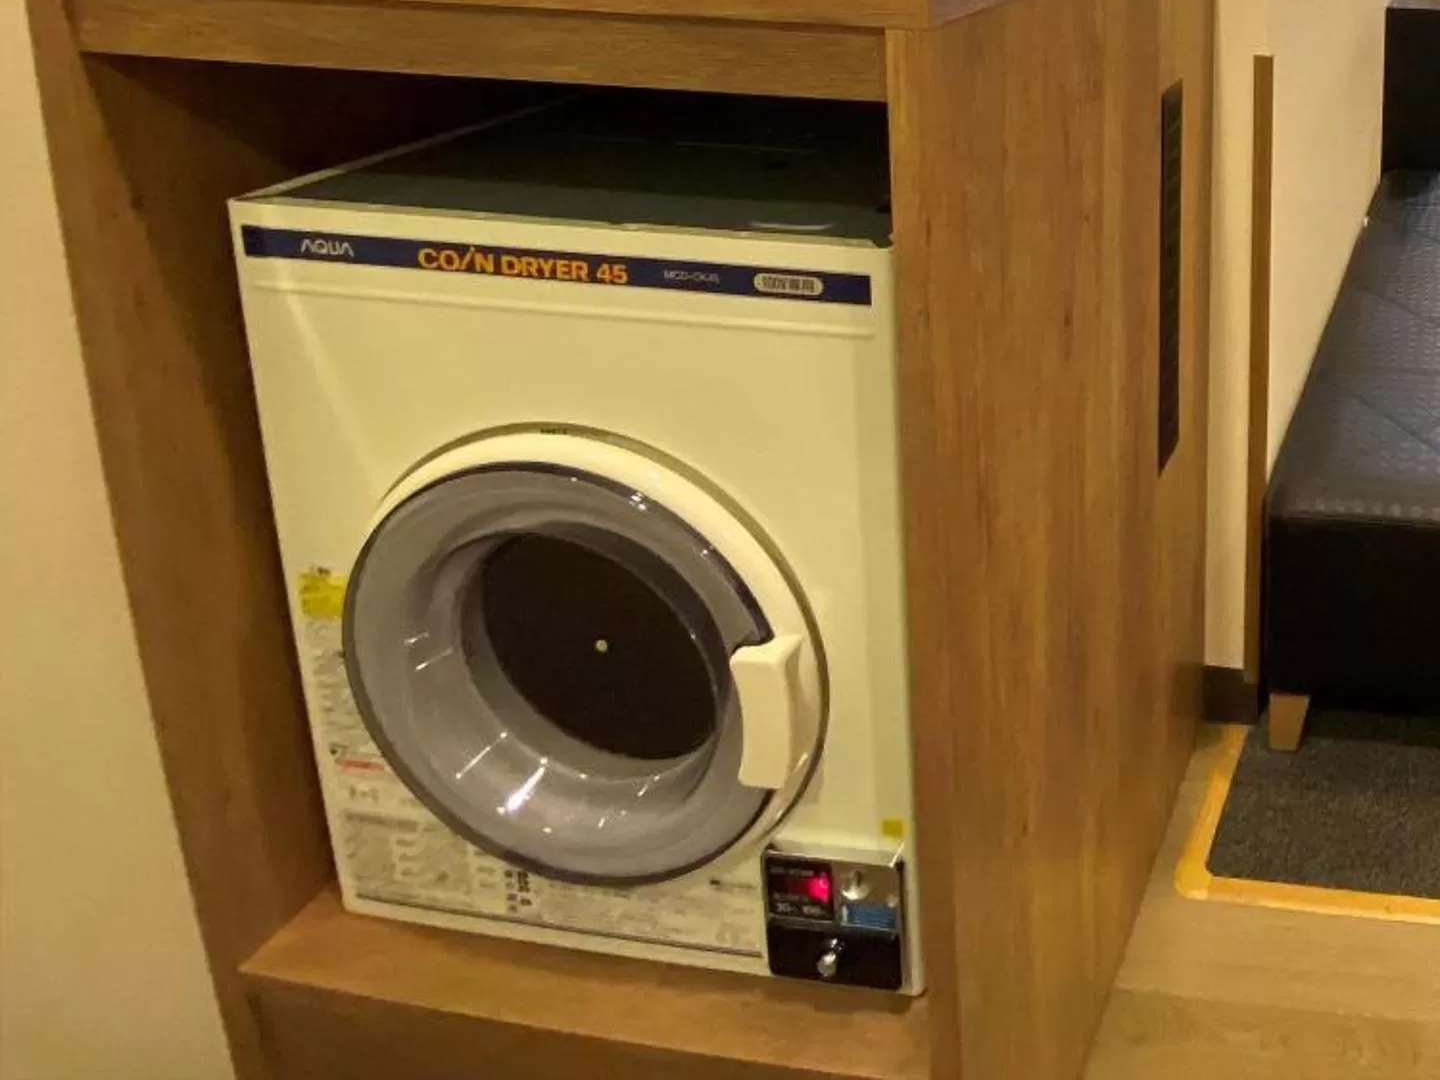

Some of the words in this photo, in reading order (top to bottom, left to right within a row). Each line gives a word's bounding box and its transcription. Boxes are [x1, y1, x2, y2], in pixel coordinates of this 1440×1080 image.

[300, 237, 356, 258] AQUA
[500, 254, 590, 283] DRYER
[596, 262, 630, 285] 45
